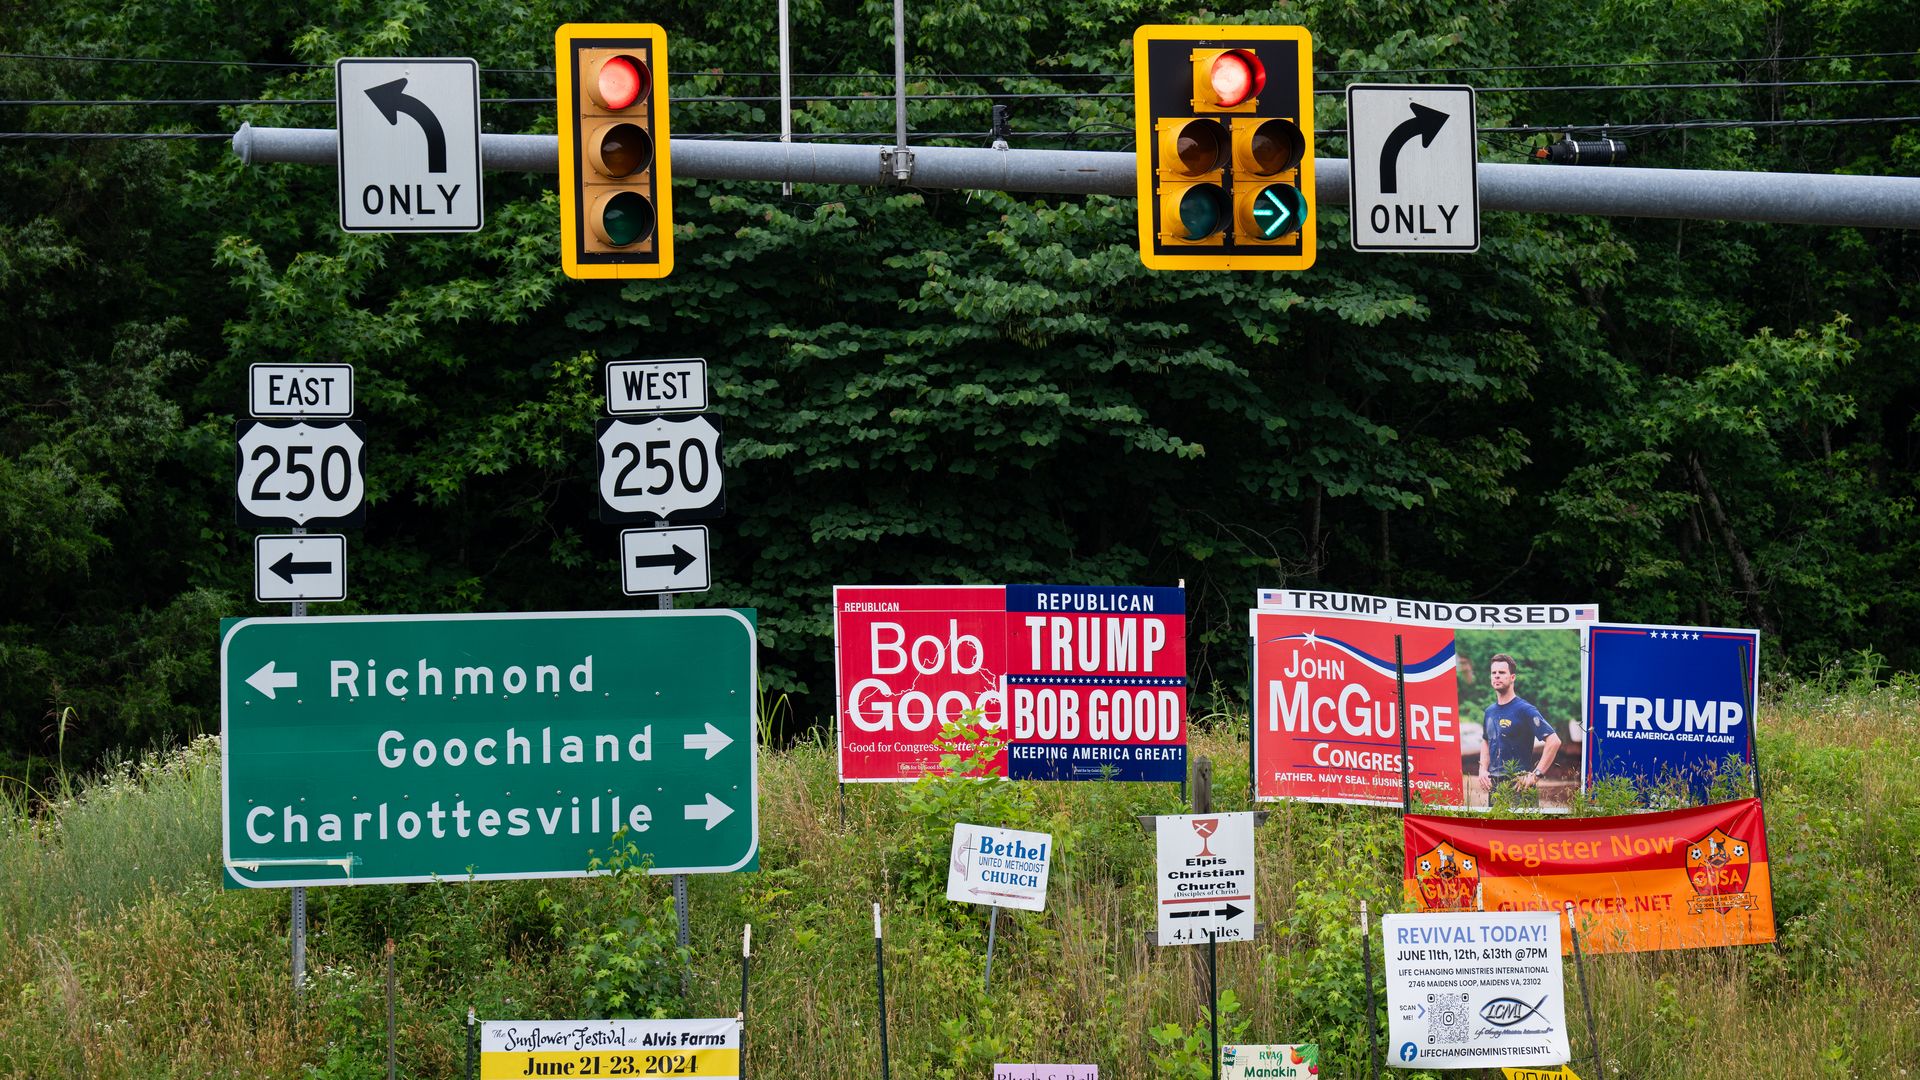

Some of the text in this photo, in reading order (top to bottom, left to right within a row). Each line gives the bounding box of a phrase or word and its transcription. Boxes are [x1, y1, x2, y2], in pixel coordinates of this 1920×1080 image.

[362, 184, 461, 215] ONLY
[1371, 204, 1460, 234] ONLY
[269, 375, 334, 406] EAST
[623, 370, 691, 401] WEST
[250, 445, 352, 502] 250
[611, 438, 709, 498] 250
[844, 602, 900, 612] REPUBLICAN
[1037, 592, 1154, 612] REPUBLICAN
[1288, 591, 1570, 624] TRUMP ENDORSED
[870, 618, 984, 676] Bob
[1025, 616, 1167, 672] TRUMP
[330, 654, 594, 698] Richmond
[1284, 649, 1345, 681] JOHN
[848, 675, 1009, 732] Good
[1014, 688, 1180, 742] BOB GOOD
[1269, 679, 1455, 742] McGURE
[1599, 695, 1744, 734] TRUMP
[378, 724, 653, 769] Goochland
[849, 742, 876, 753] Good
[877, 741, 892, 752] for
[893, 742, 942, 754] Congress.
[1606, 730, 1735, 744] MAKE AMERICA GREAT AGAIN!
[1013, 746, 1183, 761] KEEPING AMERICA GREAT!
[1312, 742, 1415, 774] CONGRESS
[1274, 772, 1316, 782] FATHER.
[1318, 774, 1343, 784] NAVY
[1345, 775, 1370, 786] SEAL.
[1372, 777, 1415, 789] BUSINES
[245, 796, 654, 845] Charlottesville
[979, 836, 1046, 862] Bethel
[1488, 834, 1675, 868] Register Now
[978, 856, 1045, 873] UNITED METHODIST
[1185, 857, 1227, 867] Elpis
[981, 869, 1038, 888] CHURCH
[1168, 869, 1245, 880] Christian
[1177, 881, 1236, 892] Church
[1693, 869, 1743, 887] GUSA
[1174, 890, 1206, 899] (Disciples
[1215, 888, 1240, 896] Christ)
[1173, 928, 1193, 940] 4.1
[1397, 924, 1547, 944] REVIVAL TODAY!
[1397, 947, 1548, 962] JUNE 11th, 12th, &13th @7PM
[1398, 966, 1550, 977] LIFE CHANGING MINISTRIES INTERNATIONAL
[1408, 980, 1426, 988] 2746
[1459, 979, 1479, 987] LOOP,
[1480, 979, 1510, 987] MAIDENS
[1523, 978, 1542, 986] 23102
[492, 1026, 726, 1052] The Sunflower Festival at Alvis Farms
[1420, 1046, 1551, 1058] LIFECHANGINGMINISTRIESINTL
[523, 1055, 699, 1077] June 21-23, 2024
[1244, 1066, 1297, 1078] Manakin
